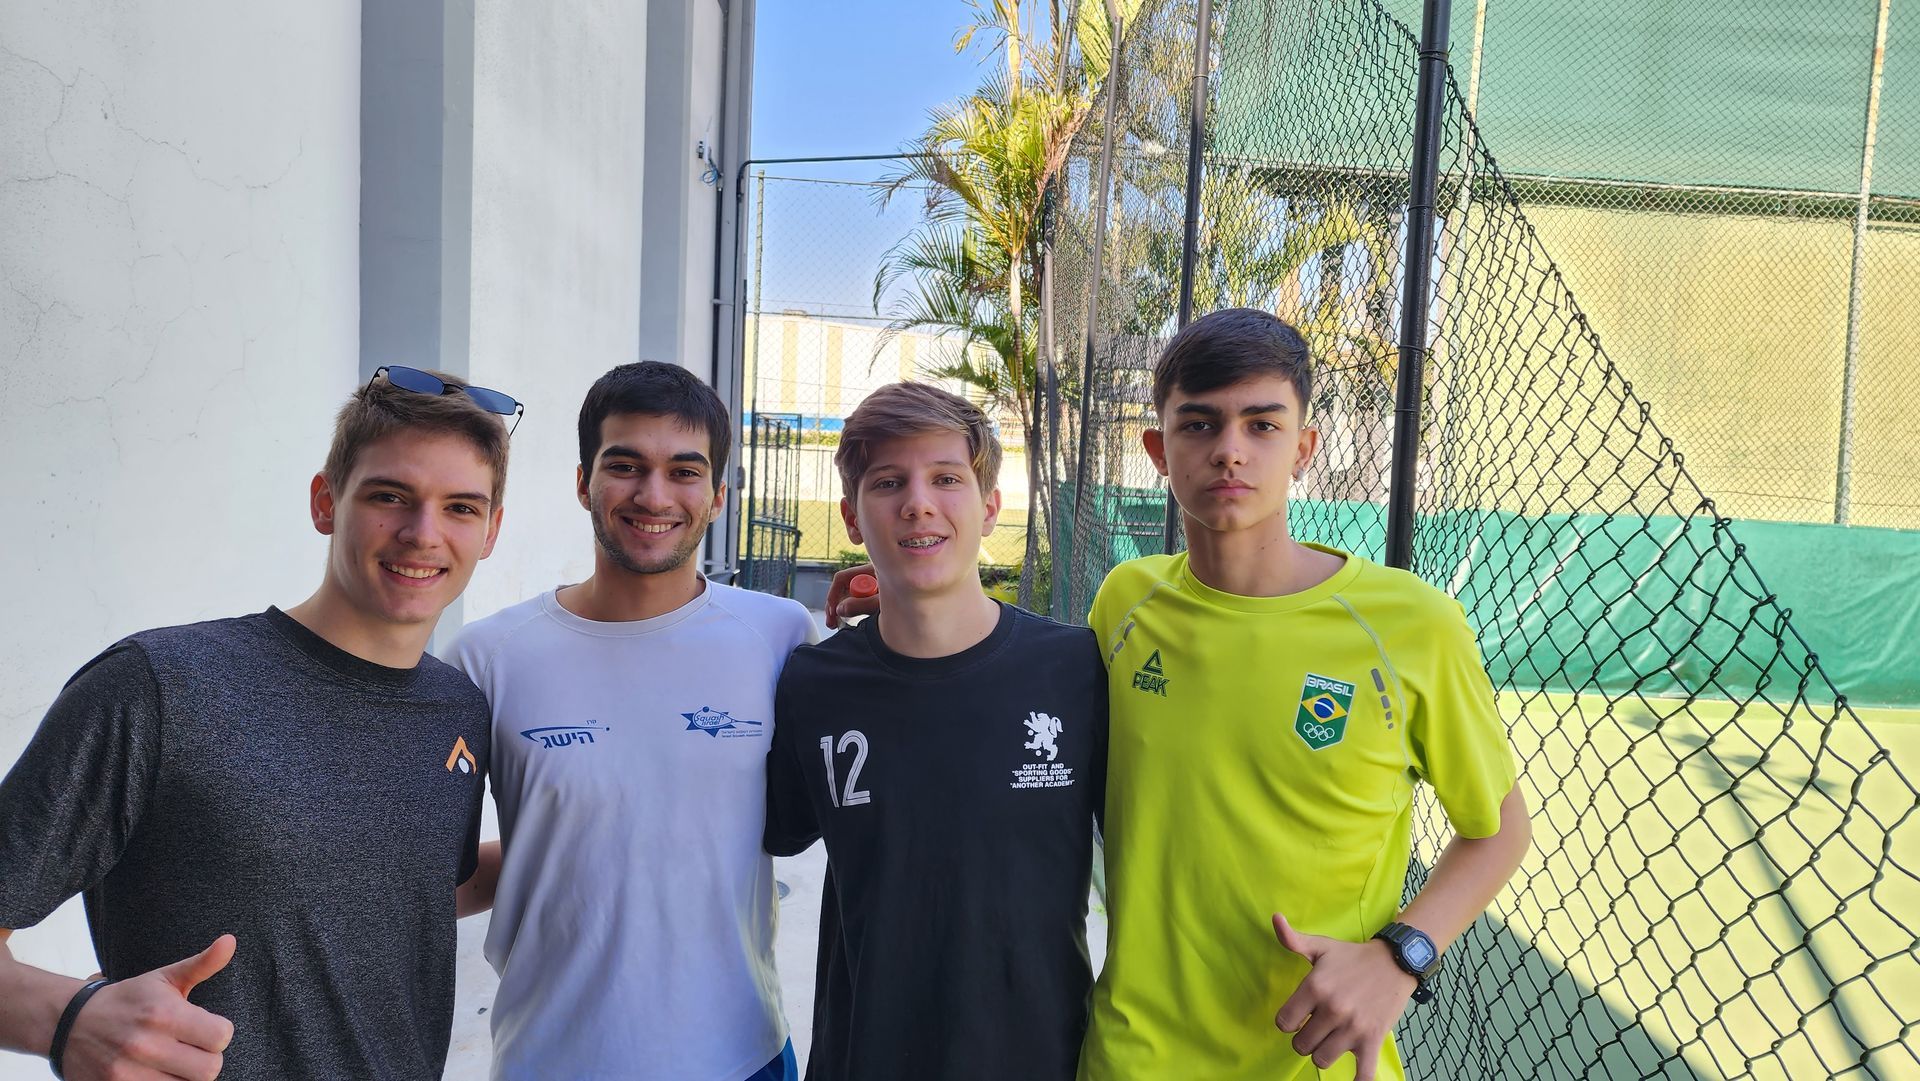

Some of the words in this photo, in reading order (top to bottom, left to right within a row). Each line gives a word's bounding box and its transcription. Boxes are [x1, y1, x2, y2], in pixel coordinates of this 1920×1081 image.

[1132, 671, 1170, 697] PEAK
[1306, 676, 1352, 697] BRASIL
[695, 714, 725, 722] Squash
[540, 731, 594, 749] הישג
[820, 730, 871, 808] 12
